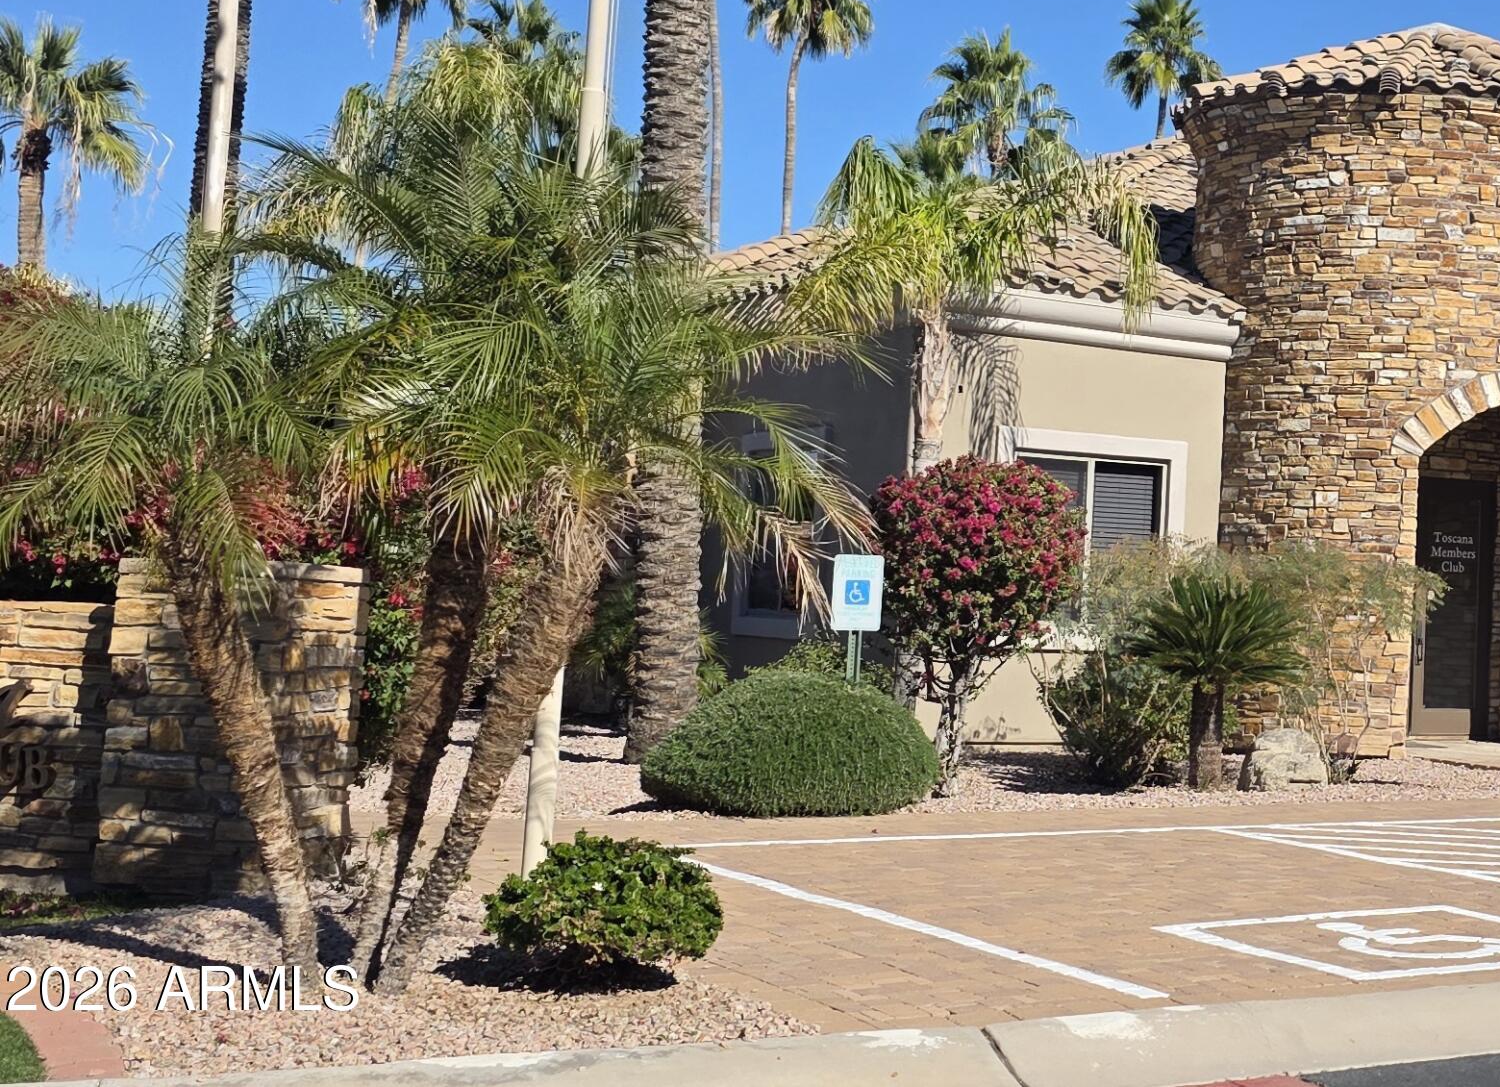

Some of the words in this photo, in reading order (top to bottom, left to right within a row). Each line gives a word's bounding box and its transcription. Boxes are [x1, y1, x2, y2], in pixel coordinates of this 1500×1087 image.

[1432, 531, 1474, 545] Toscana
[1430, 545, 1476, 559] Members
[1441, 560, 1465, 573] Club
